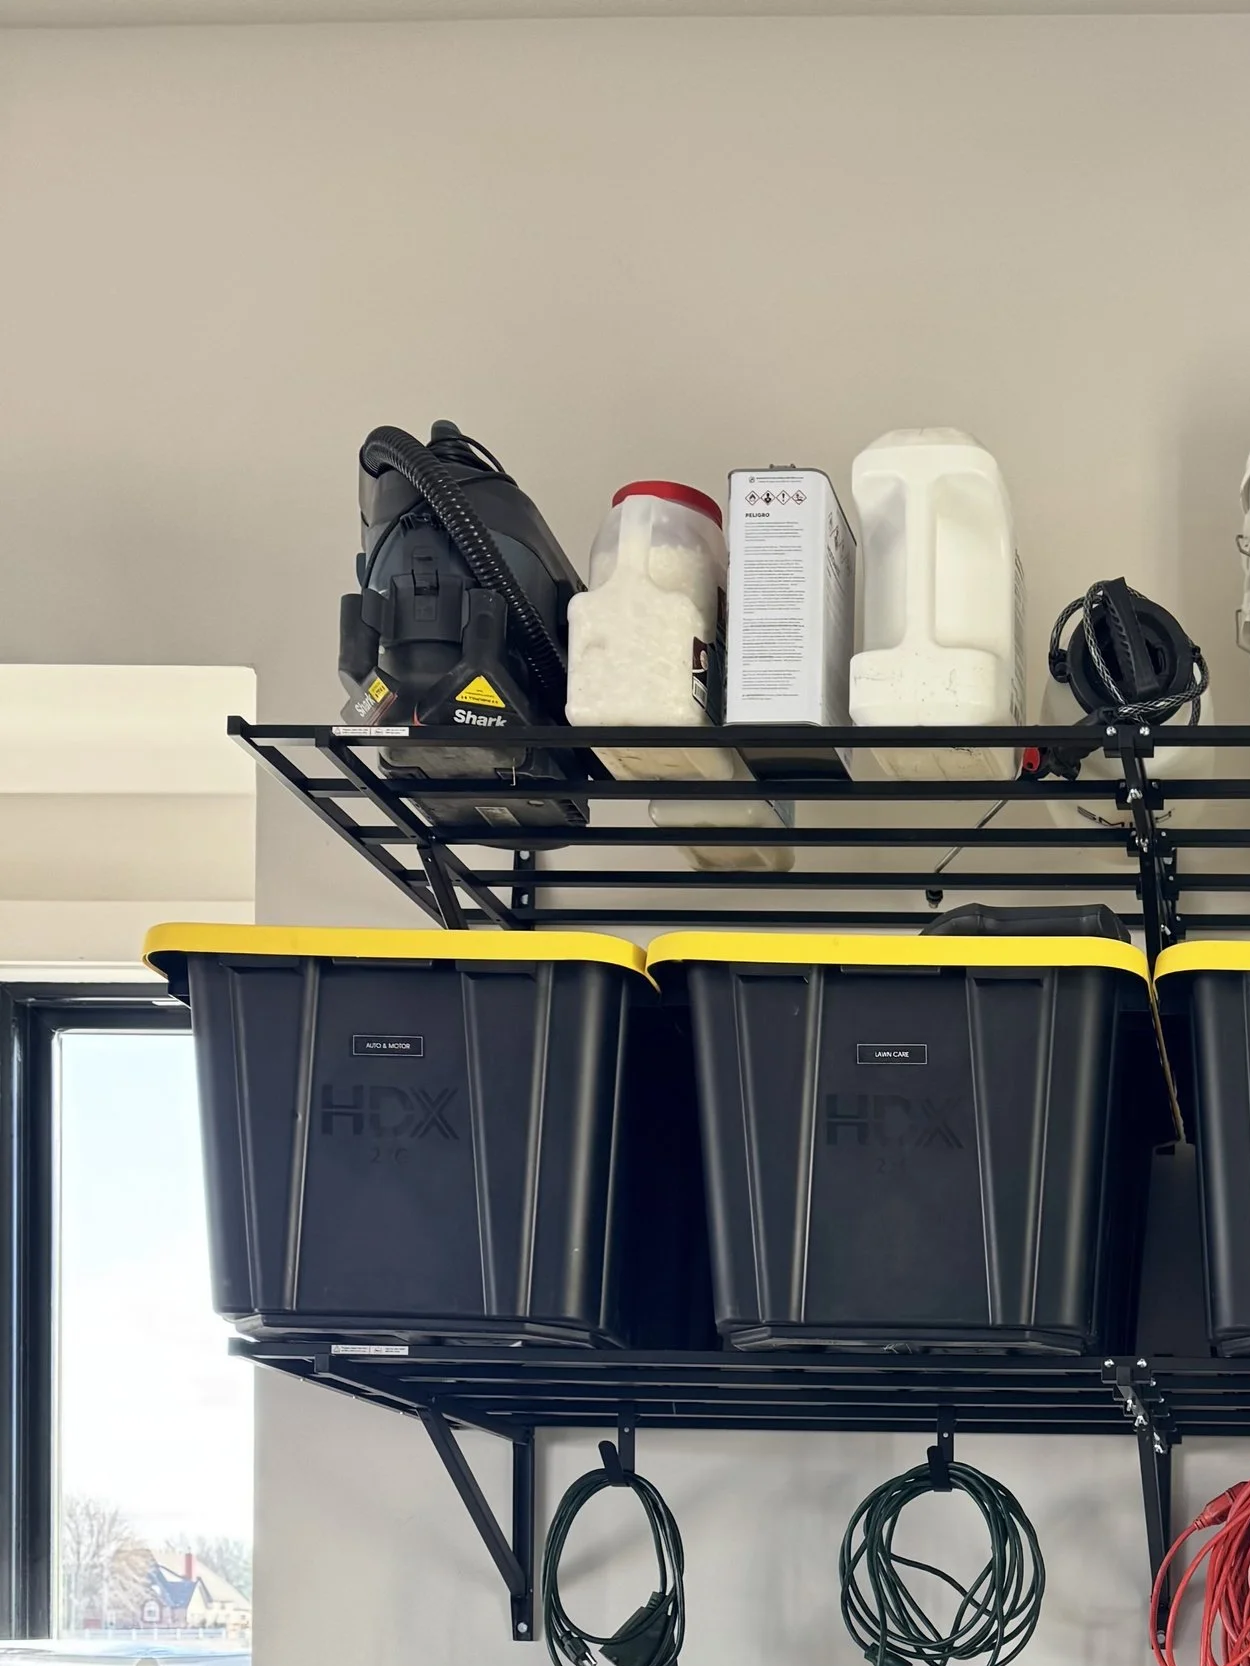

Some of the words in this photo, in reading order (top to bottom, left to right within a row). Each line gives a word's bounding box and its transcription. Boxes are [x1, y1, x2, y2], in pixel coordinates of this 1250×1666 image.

[354, 692, 377, 717] Shark
[453, 708, 508, 727] Shark
[321, 1084, 460, 1140] HDX
[826, 1094, 964, 1149] HDX
